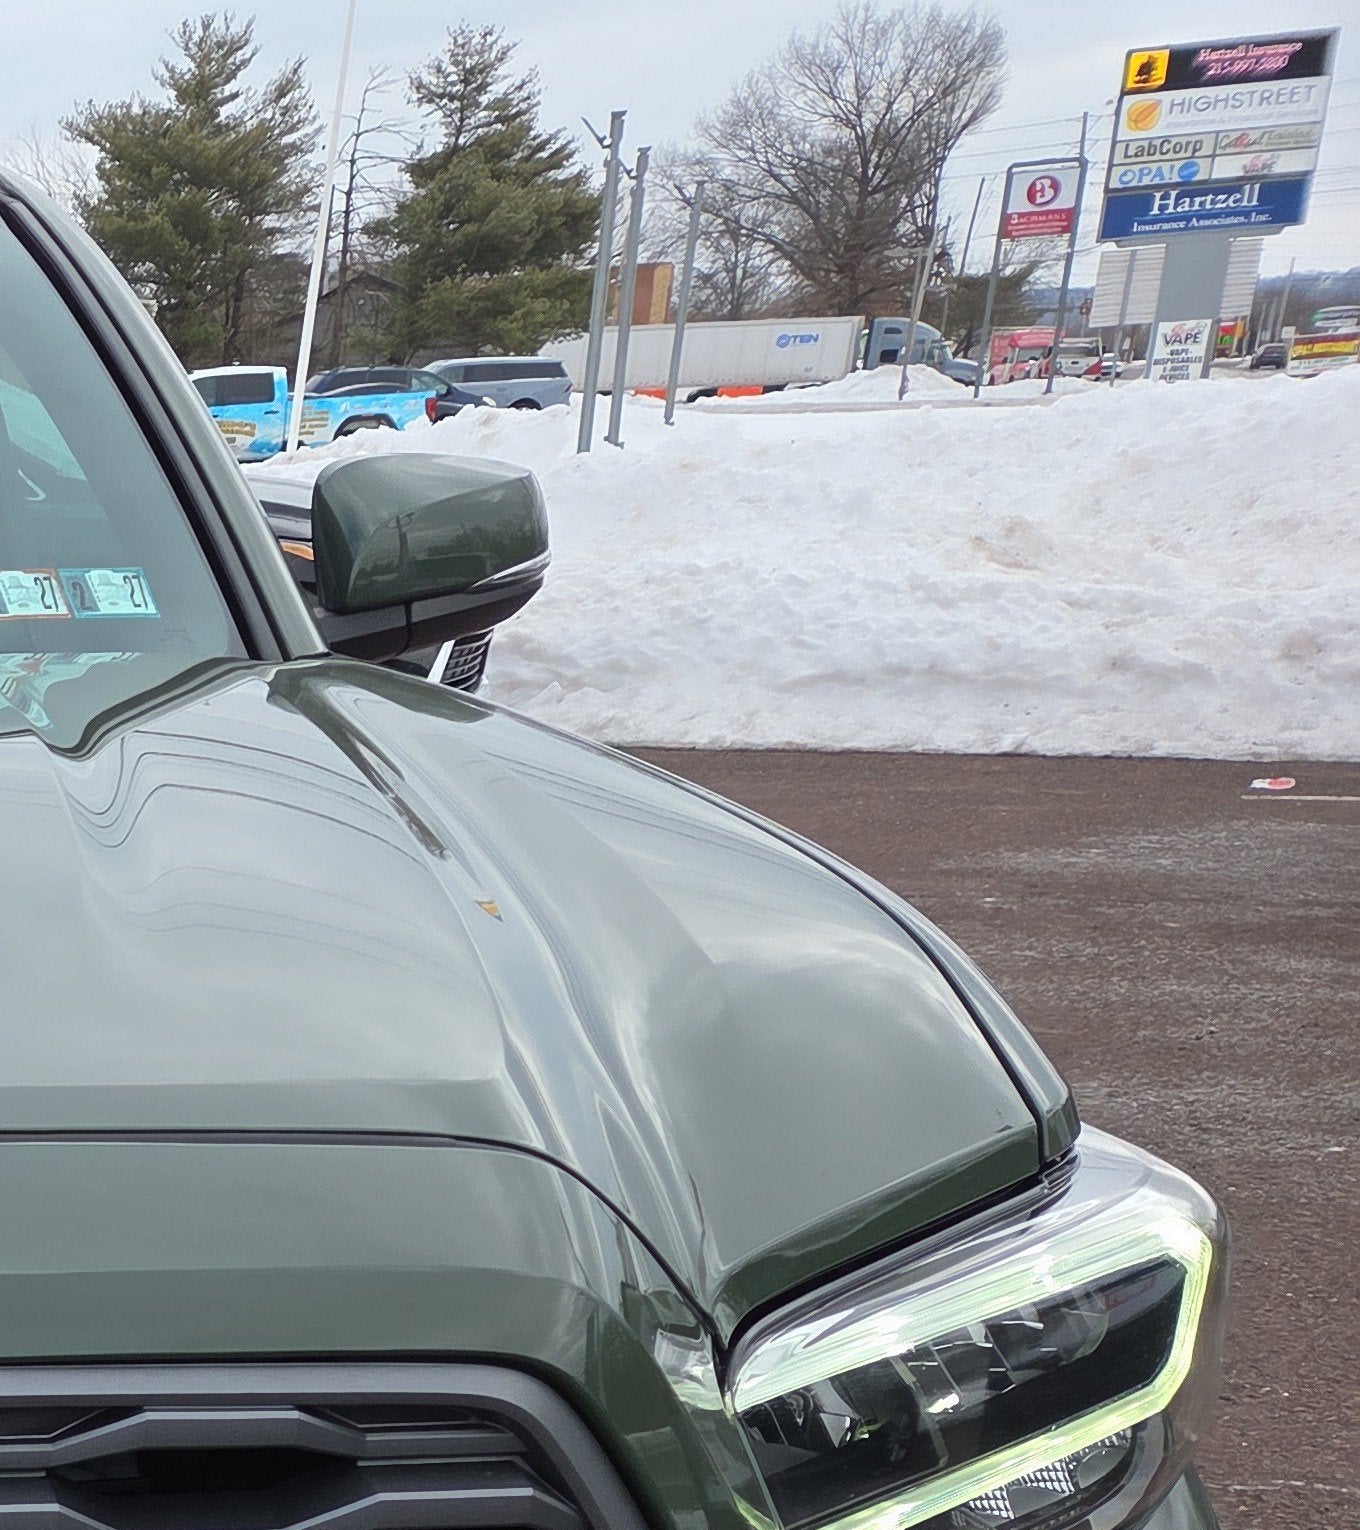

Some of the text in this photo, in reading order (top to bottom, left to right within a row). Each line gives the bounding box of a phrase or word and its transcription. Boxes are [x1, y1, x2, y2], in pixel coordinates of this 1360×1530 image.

[1169, 84, 1318, 115] HIGHSTREET
[1123, 138, 1204, 160] LabCorp
[1118, 164, 1175, 186] OPA!
[1149, 183, 1261, 215] Hartzell
[1133, 211, 1273, 233] Insurance Associates, Inc.
[1163, 332, 1202, 346] VAPE
[33, 576, 60, 613] 27
[71, 574, 149, 611] 2 27
